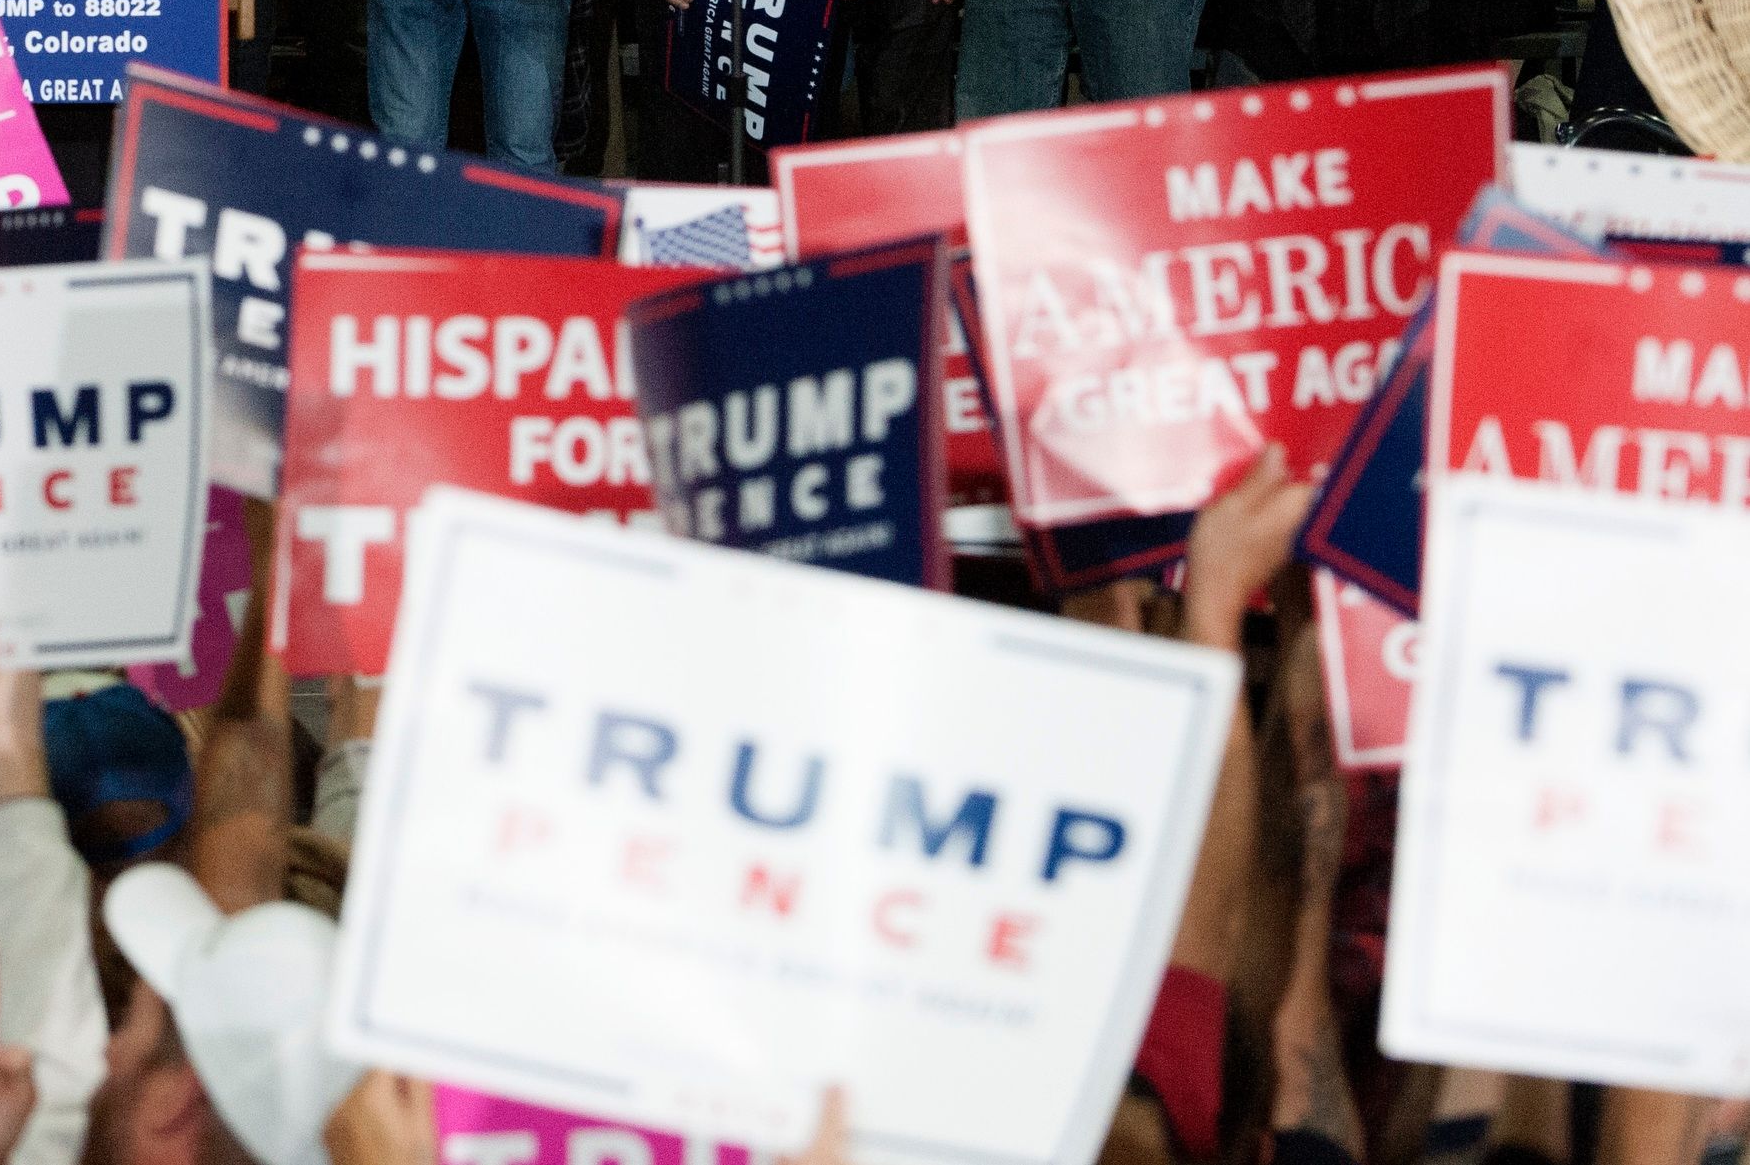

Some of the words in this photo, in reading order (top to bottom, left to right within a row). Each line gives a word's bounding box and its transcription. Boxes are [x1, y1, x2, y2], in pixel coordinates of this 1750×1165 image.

[25, 29, 149, 54] Colorado
[53, 0, 76, 18] to
[704, 26, 714, 61] GREAT
[39, 78, 104, 102] GREAT
[1165, 148, 1354, 223] MAKE
[1013, 221, 1434, 359] AMERIC
[1060, 352, 1280, 435] GREAT
[509, 416, 650, 486] FOR
[462, 679, 1131, 883] TRUMP
[493, 803, 1043, 973] PENCE
